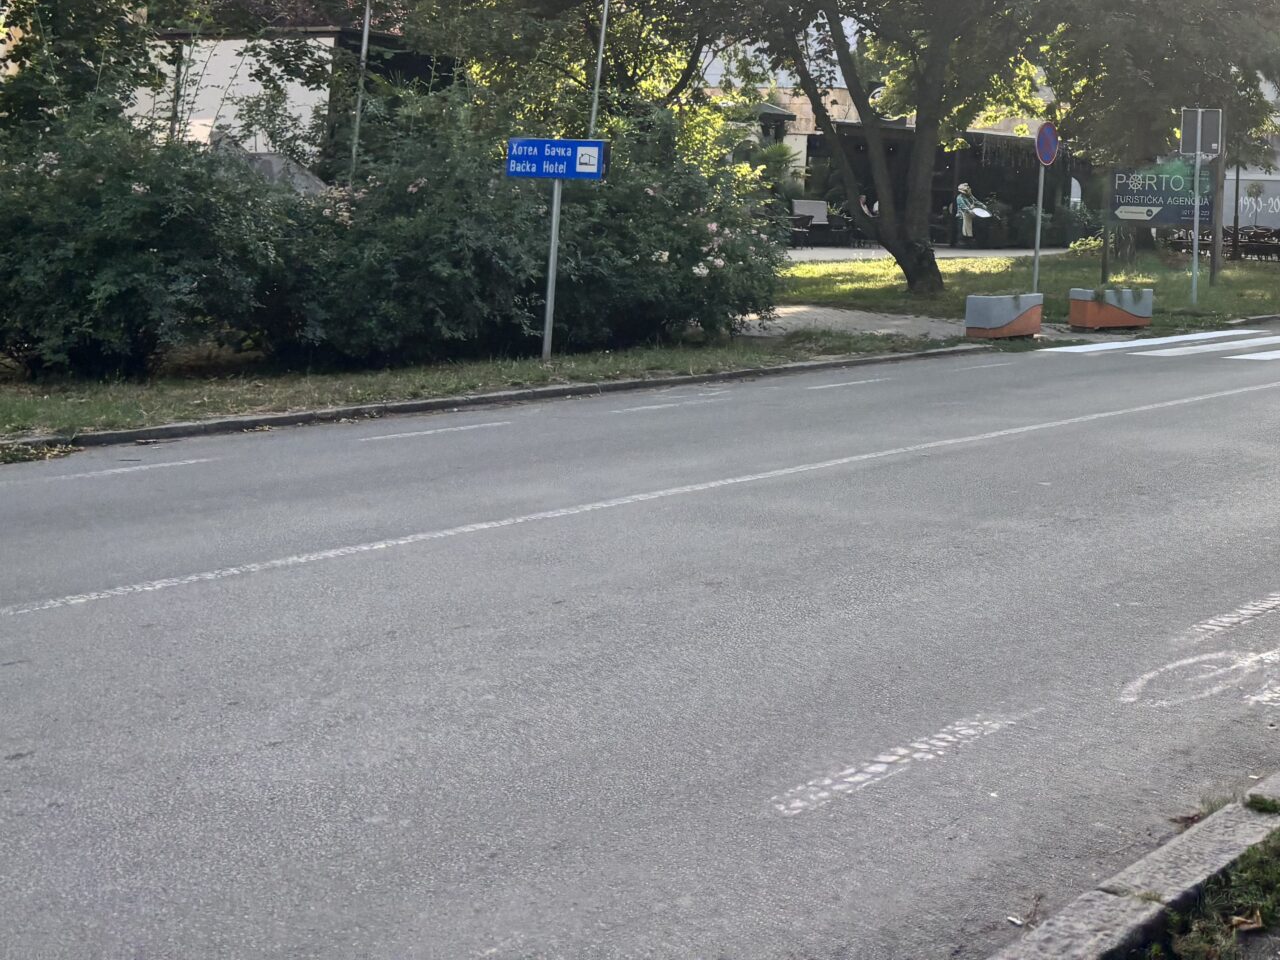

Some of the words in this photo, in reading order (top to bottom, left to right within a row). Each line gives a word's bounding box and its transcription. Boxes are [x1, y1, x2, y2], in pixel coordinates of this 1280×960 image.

[511, 143, 538, 156] Хотел
[544, 144, 572, 157] Бачка
[509, 160, 537, 173] Bačka
[543, 161, 567, 174] Hotel
[1115, 172, 1185, 193] PORTO
